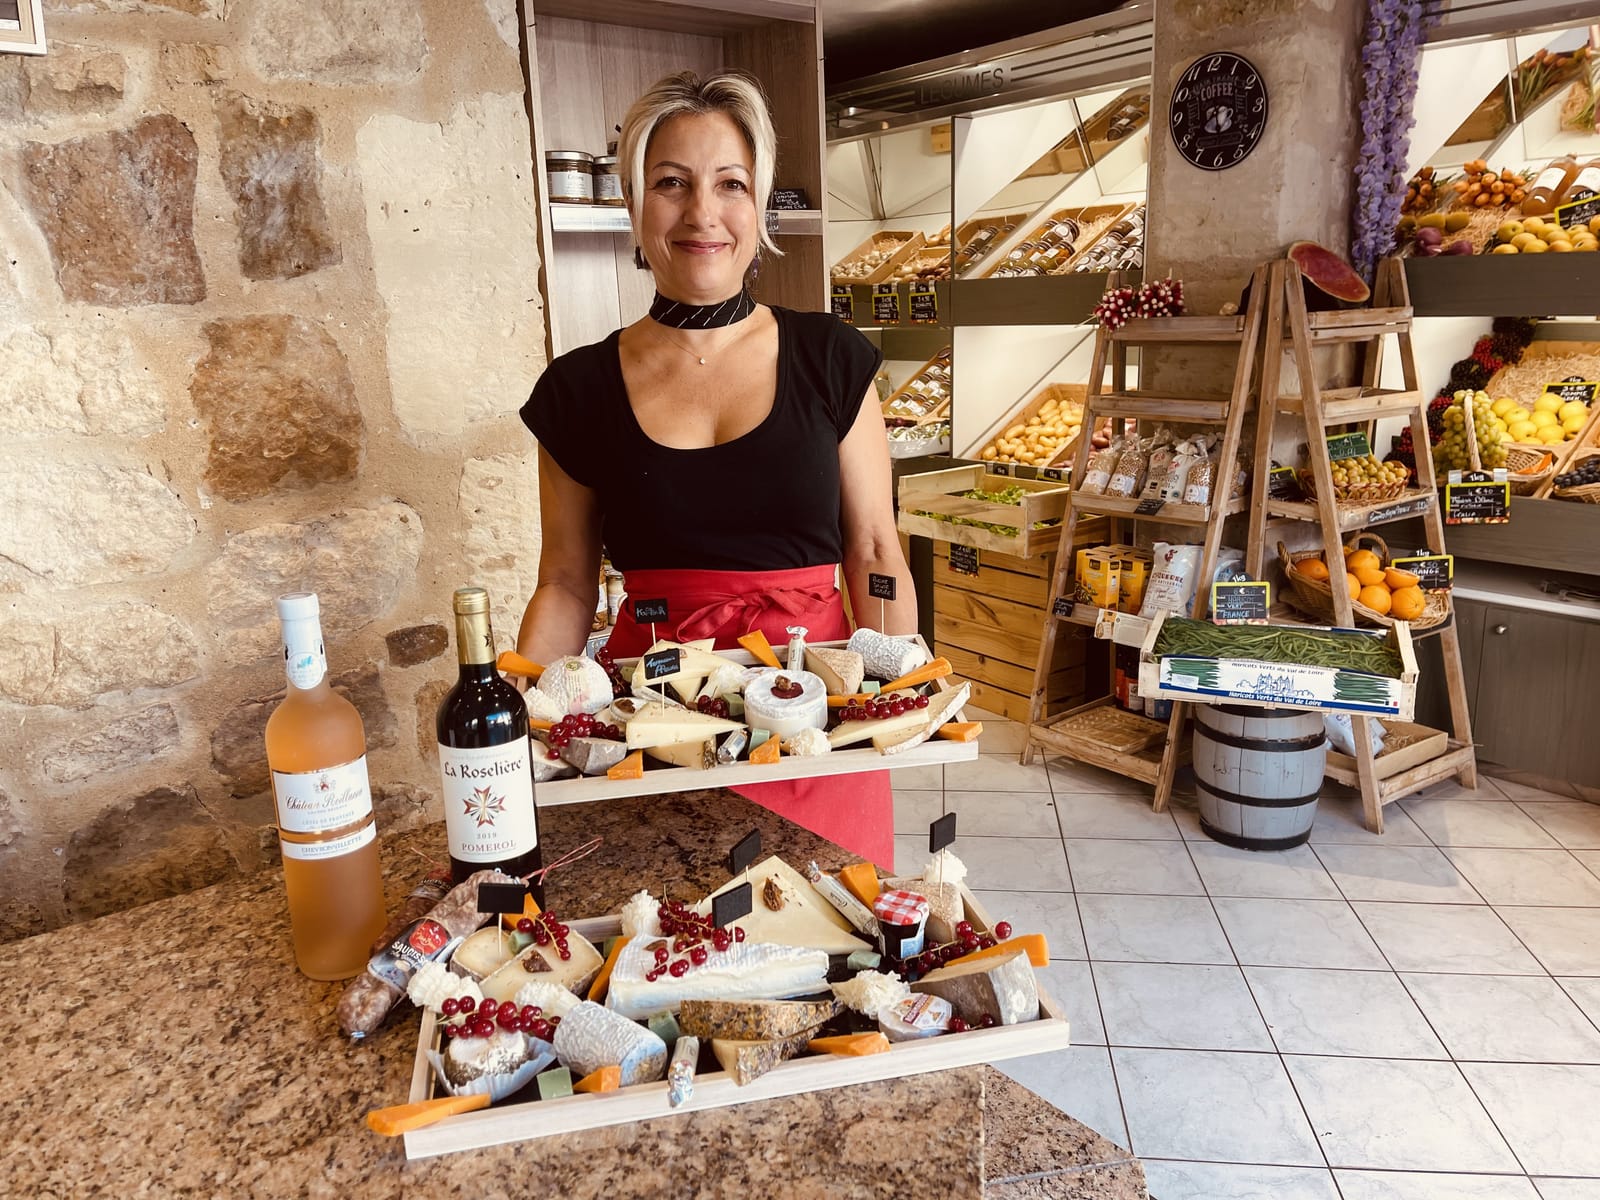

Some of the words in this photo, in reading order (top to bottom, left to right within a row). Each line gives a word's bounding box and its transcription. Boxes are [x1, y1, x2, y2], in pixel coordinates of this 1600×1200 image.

[1207, 56, 1222, 73] 12
[1230, 60, 1239, 76] 1
[1187, 65, 1201, 82] 11
[1245, 74, 1256, 90] 2
[1175, 87, 1189, 103] 10
[1200, 82, 1234, 101] COFFEE
[1252, 97, 1264, 113] 3
[1174, 111, 1183, 128] 9
[1246, 122, 1261, 139] 4
[1180, 133, 1191, 149] 8
[1195, 148, 1205, 162] 7
[1233, 144, 1245, 159] 5
[1213, 152, 1223, 167] 6
[1469, 473, 1485, 482] 1kg
[1415, 548, 1430, 557] 1kg
[1232, 574, 1247, 583] 1kg
[1222, 610, 1250, 618] FRANCE
[1307, 668, 1325, 676] Loire
[1256, 693, 1273, 701] Verts
[1284, 696, 1295, 704] Val
[1305, 698, 1322, 706] Loire
[443, 761, 457, 777] La
[460, 759, 522, 779] Roselière
[476, 832, 497, 840] 2019
[461, 839, 517, 852] POMEROL
